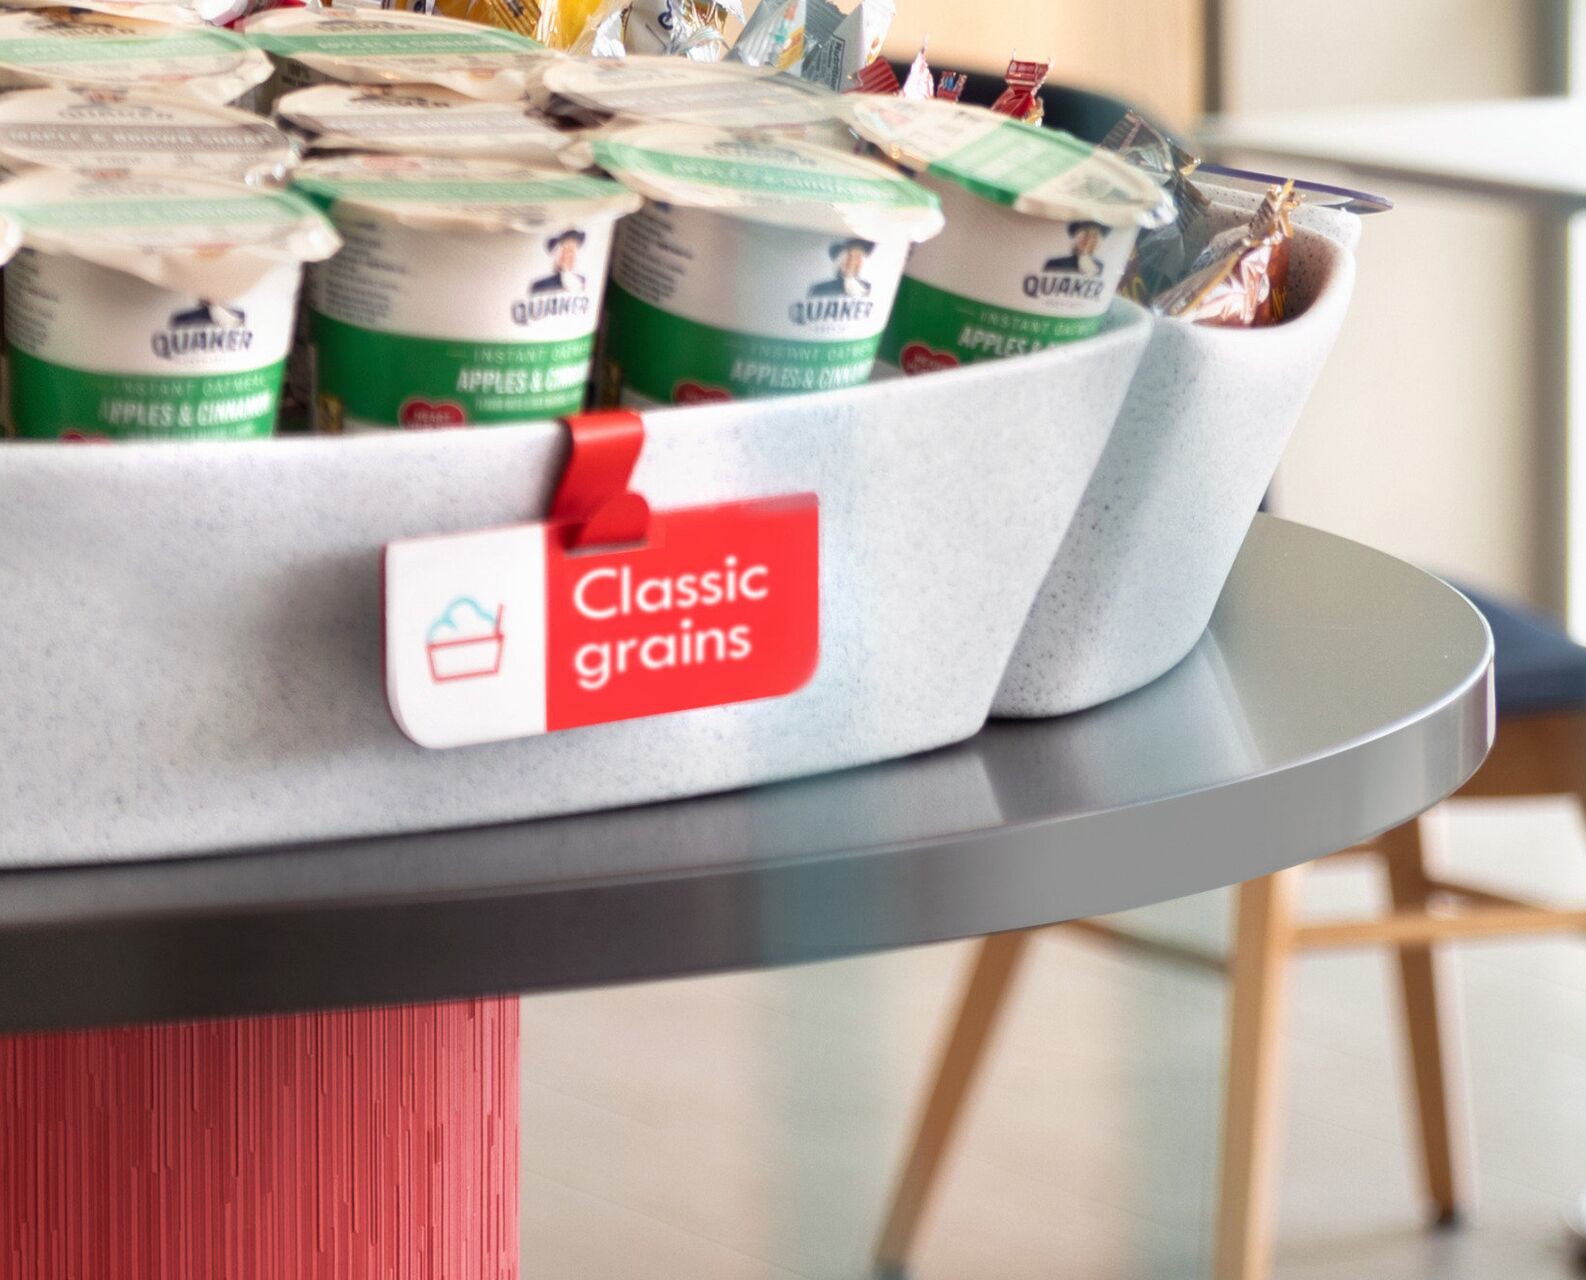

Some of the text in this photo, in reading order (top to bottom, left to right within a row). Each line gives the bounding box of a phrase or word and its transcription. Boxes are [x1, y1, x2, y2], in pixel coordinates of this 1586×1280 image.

[1023, 275, 1106, 301] QUAKER
[511, 296, 590, 326] QUAKER
[788, 300, 874, 325] QUAKER
[152, 329, 253, 360] QUAKER
[473, 346, 546, 364] INSTANT
[456, 366, 529, 395] APPLES
[530, 368, 545, 393] &
[730, 359, 800, 389] APPLES
[572, 555, 769, 620] Classic
[574, 618, 752, 690] grains
